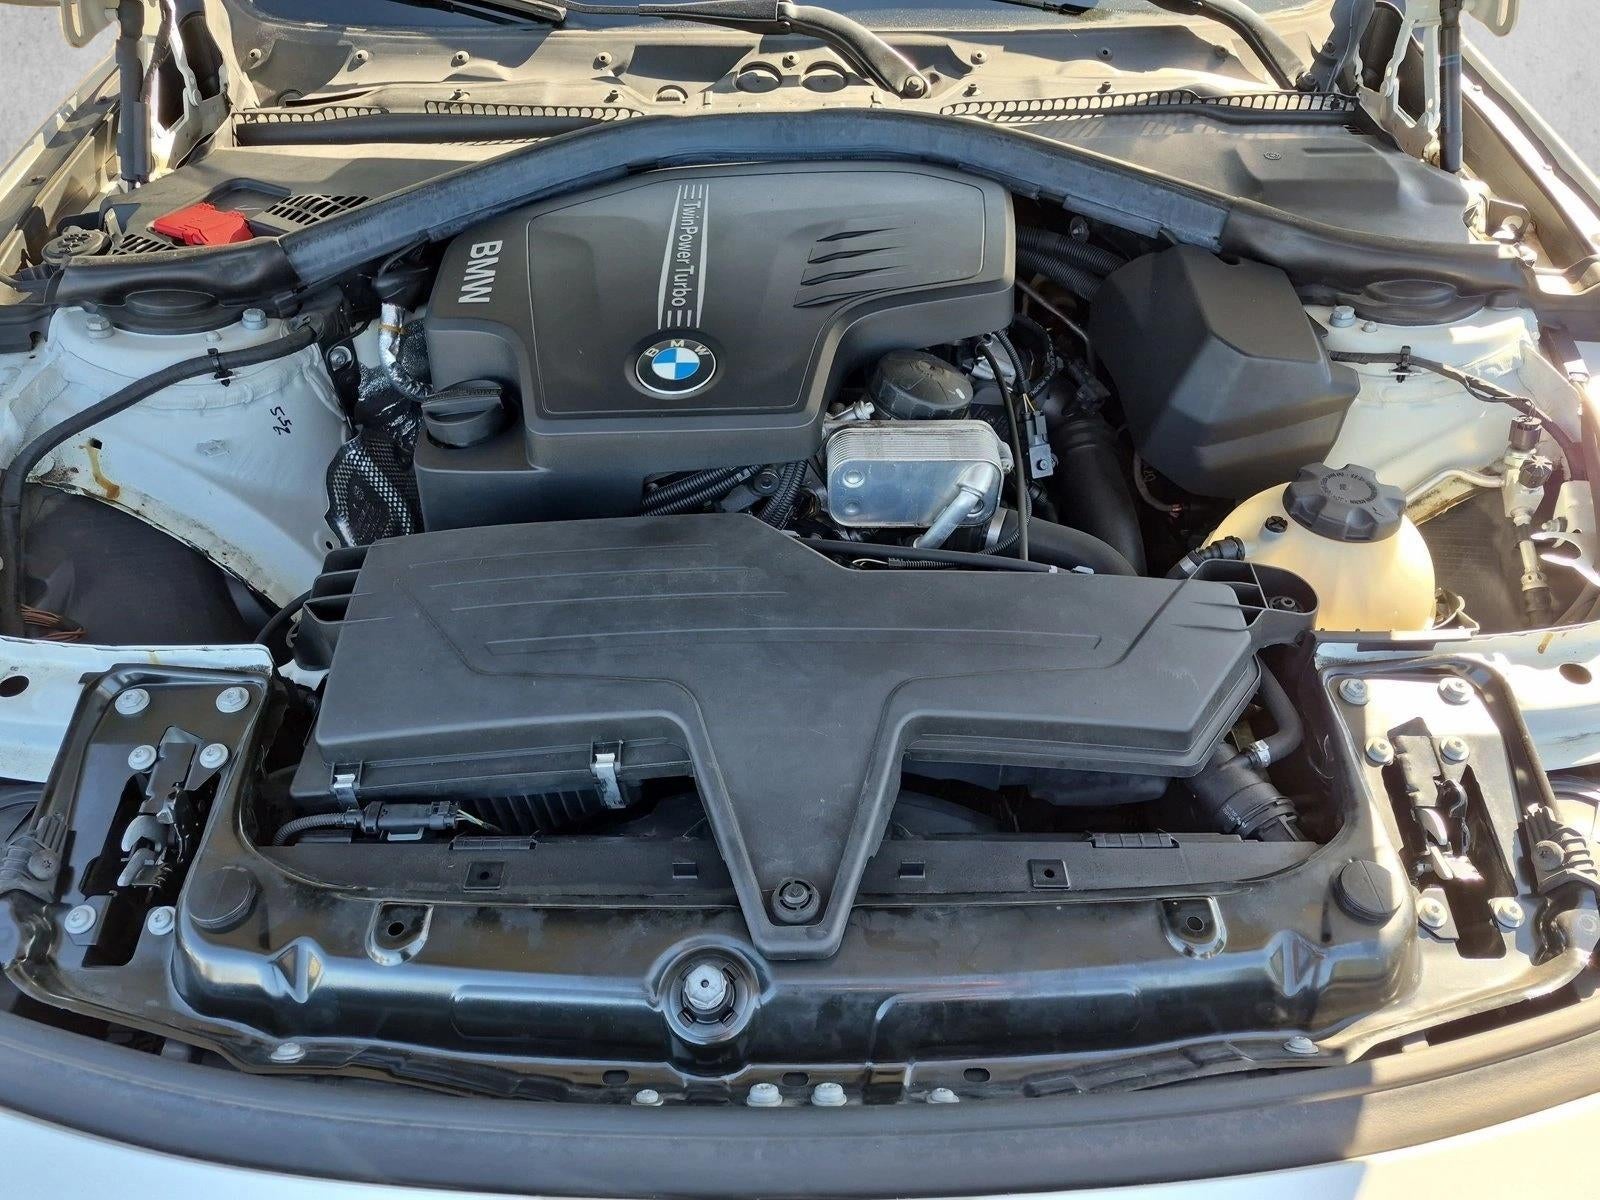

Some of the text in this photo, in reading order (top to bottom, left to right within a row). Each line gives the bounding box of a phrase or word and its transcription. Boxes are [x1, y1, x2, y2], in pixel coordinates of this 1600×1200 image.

[458, 240, 503, 303] BMW
[671, 201, 701, 307] TwinPower Turbo
[645, 339, 710, 357] BMW
